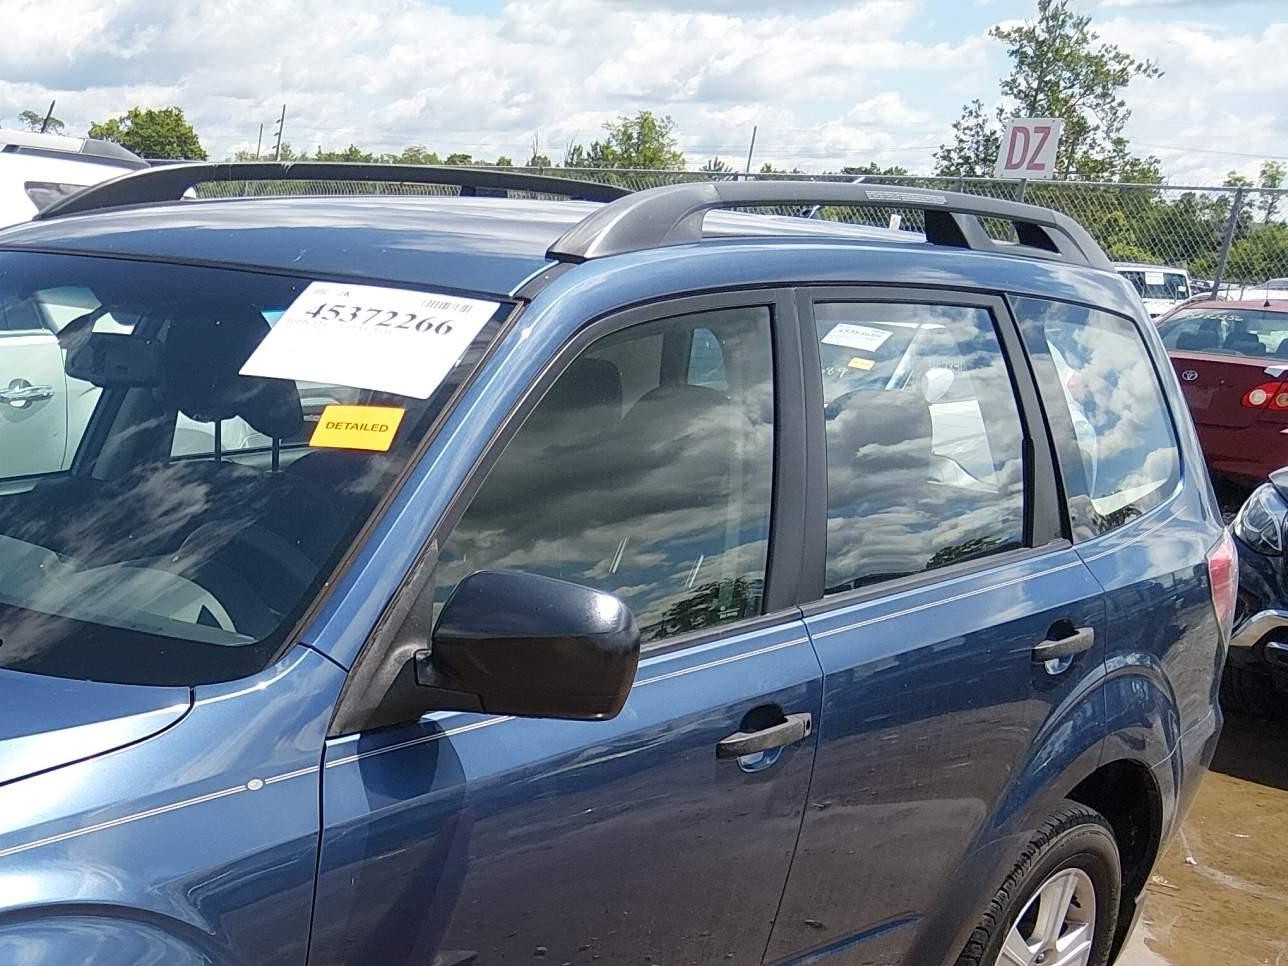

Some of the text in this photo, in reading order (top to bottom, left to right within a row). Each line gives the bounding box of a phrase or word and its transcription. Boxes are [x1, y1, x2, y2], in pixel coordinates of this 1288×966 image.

[1004, 126, 1052, 170] DZ
[305, 302, 456, 337] 45372266
[324, 421, 389, 433] DETAILED
